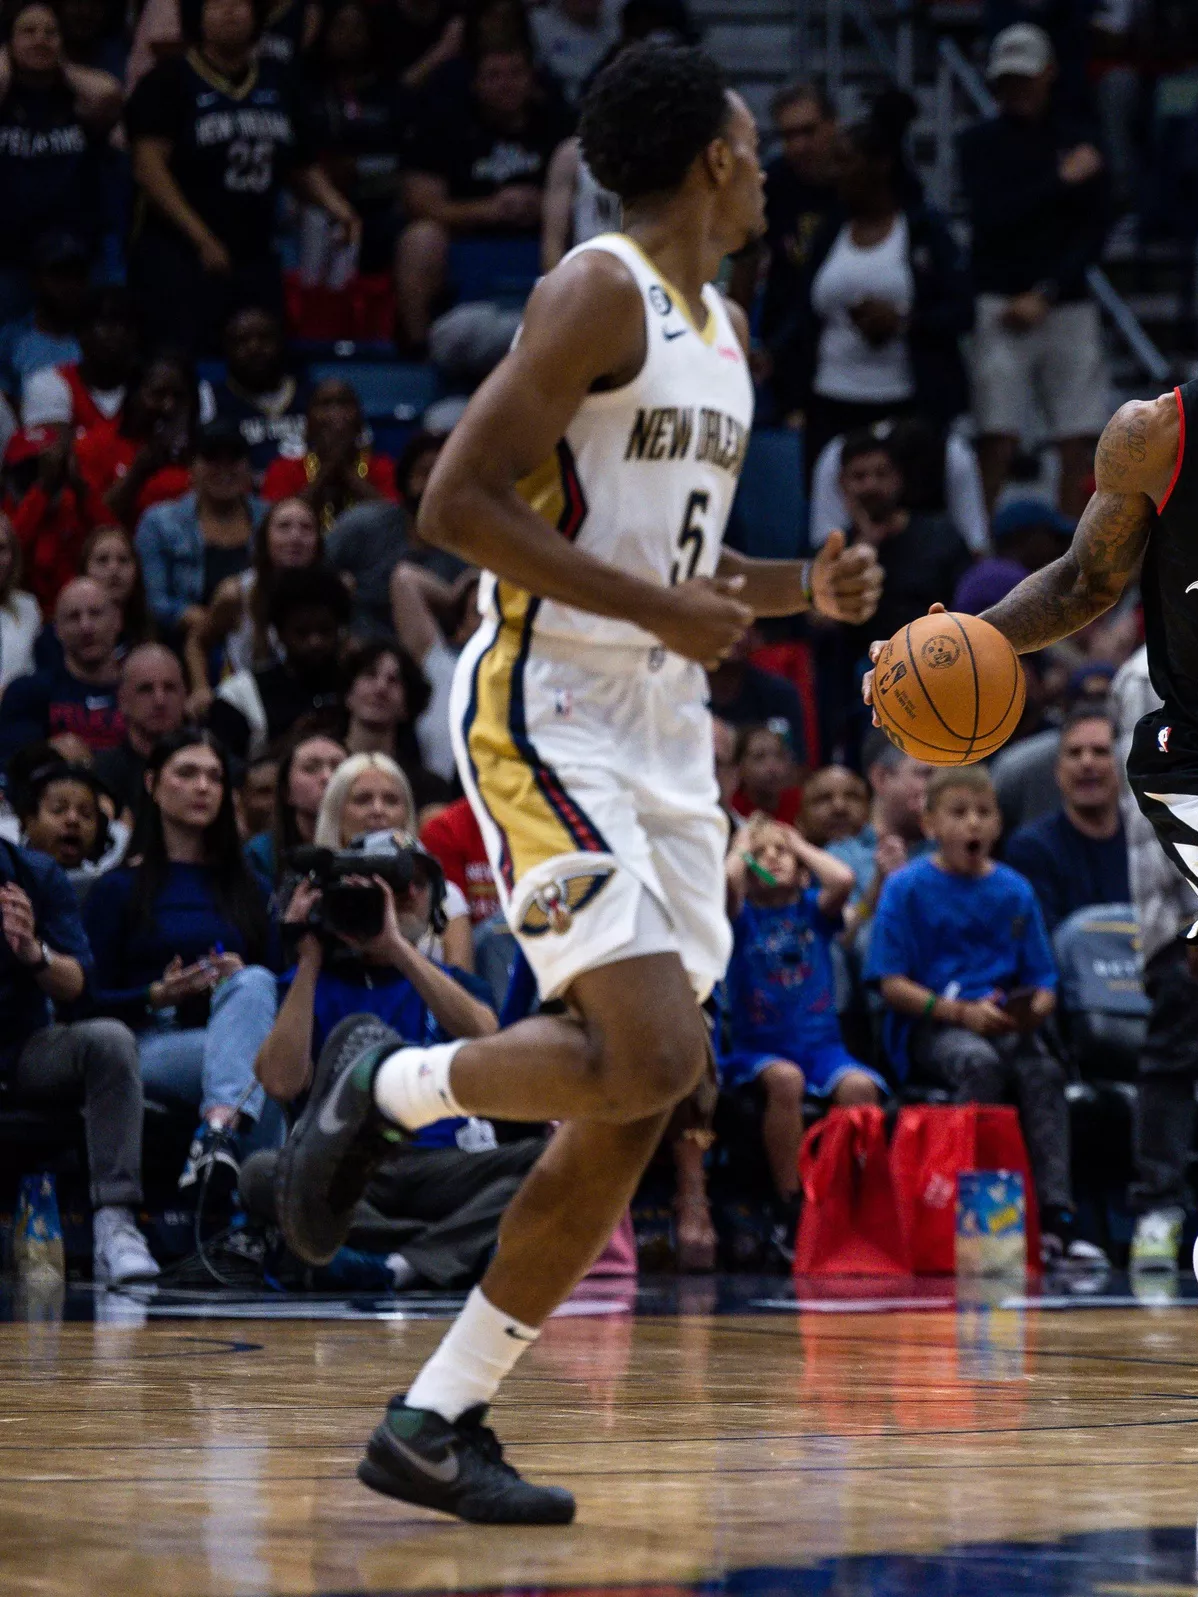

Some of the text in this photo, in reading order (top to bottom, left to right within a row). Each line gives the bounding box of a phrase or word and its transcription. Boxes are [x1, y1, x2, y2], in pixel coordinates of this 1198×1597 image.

[624, 406, 748, 477] NEW ORLE
[670, 488, 711, 587] 5
